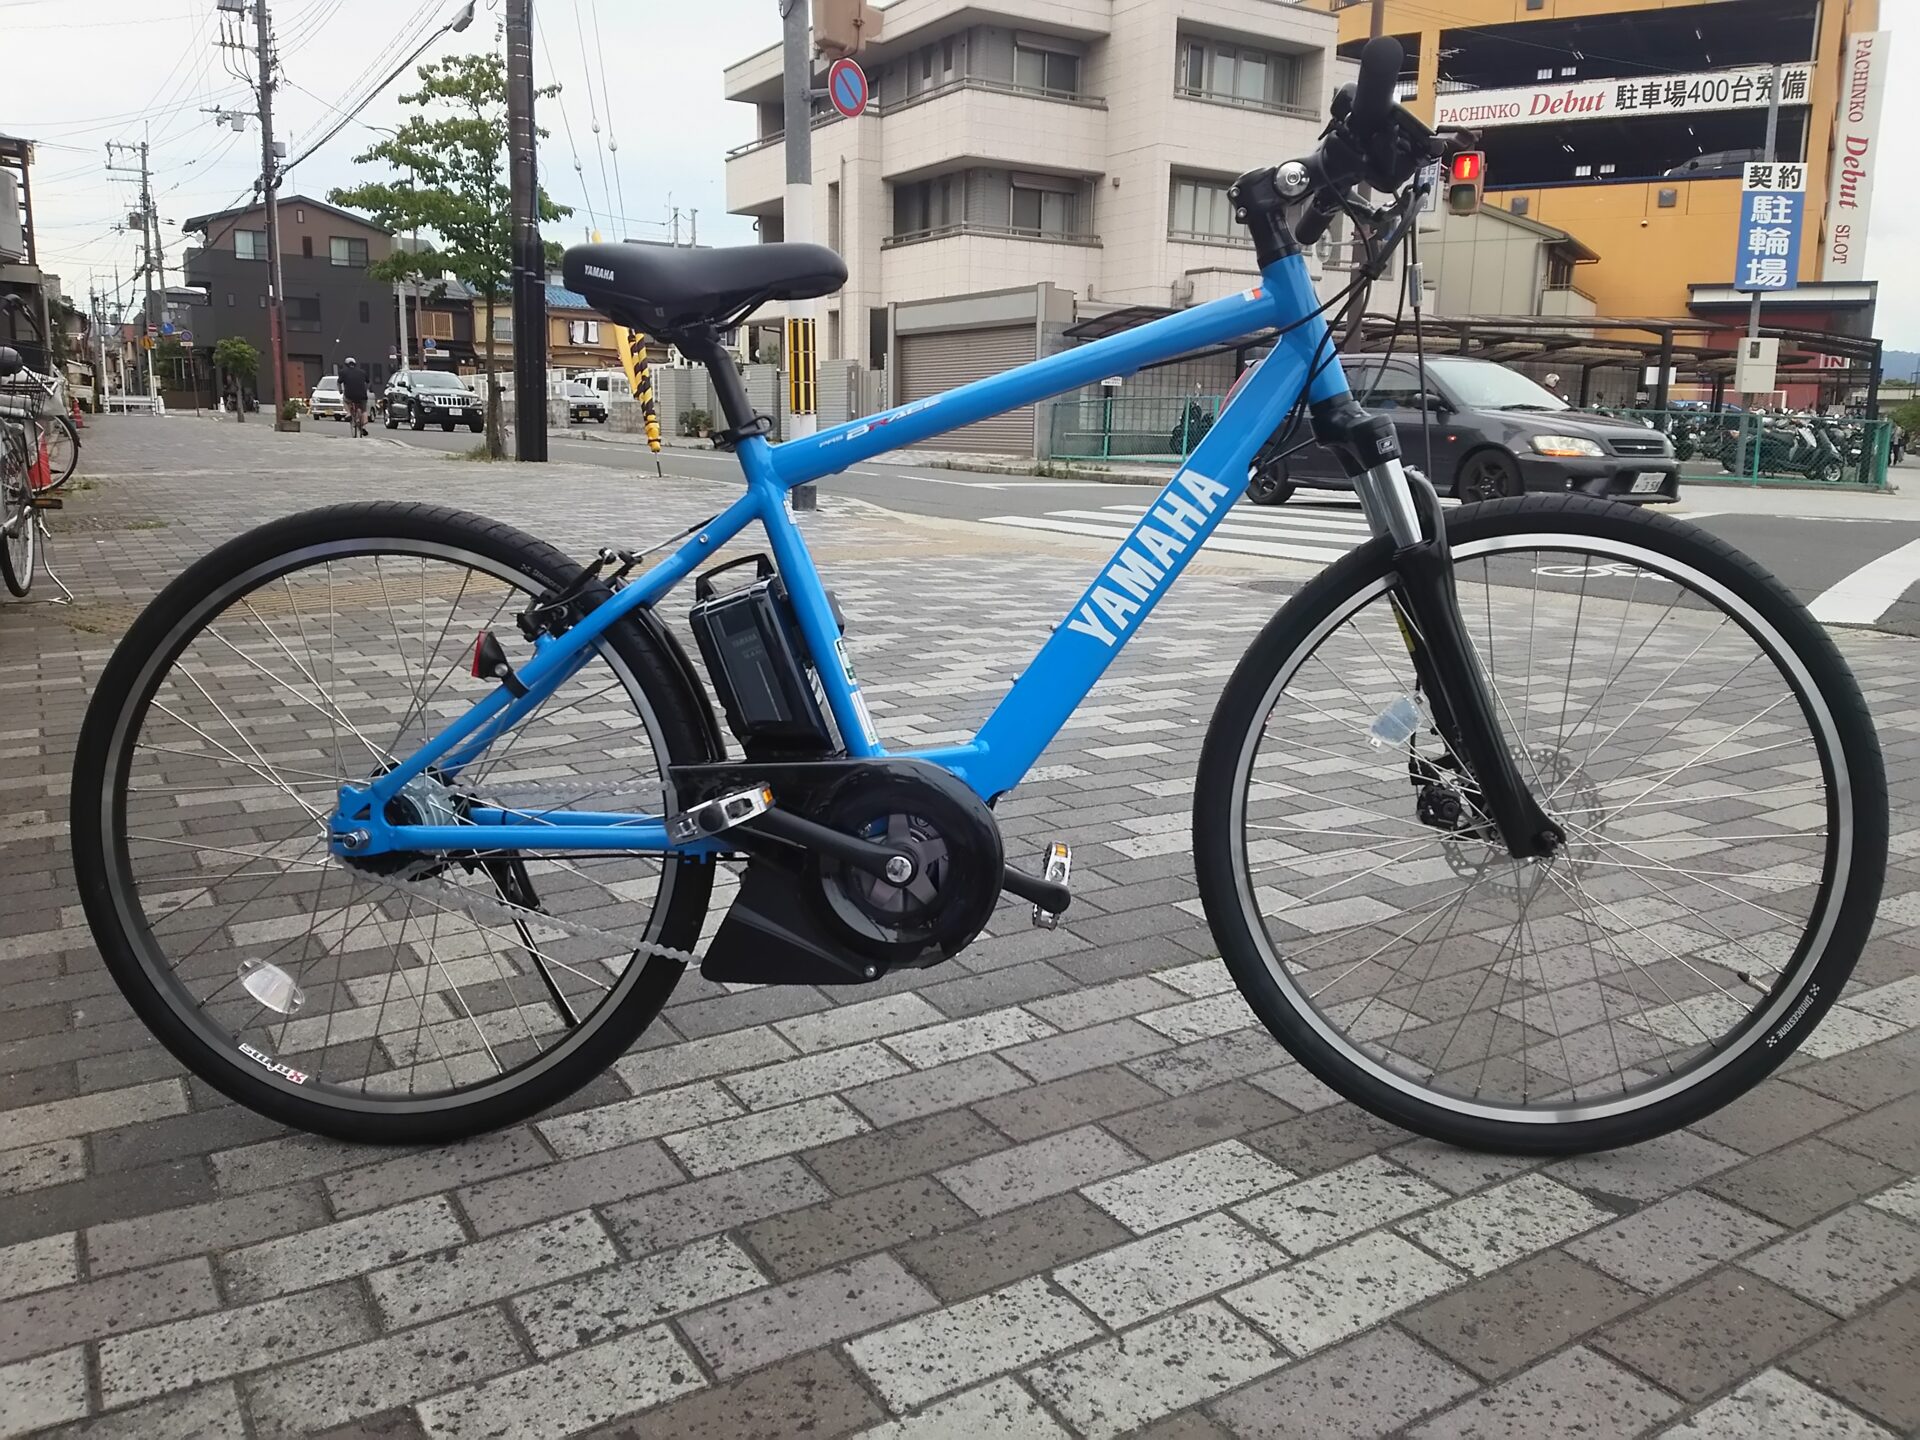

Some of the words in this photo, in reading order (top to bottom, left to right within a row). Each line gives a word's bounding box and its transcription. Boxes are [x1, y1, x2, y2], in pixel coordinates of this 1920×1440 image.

[1848, 38, 1873, 123] PACHINKO
[1439, 102, 1521, 123] PACHINKO
[1528, 89, 1607, 116] Debut
[1748, 165, 1802, 190] 契約
[1839, 135, 1869, 209] Debut
[1745, 195, 1794, 287] 駐輪場
[1832, 224, 1851, 264] SLOT
[584, 264, 615, 282] YAMAHA
[1824, 356, 1845, 368] IN
[1067, 469, 1230, 647] YAMAHA
[1776, 995, 1814, 1039] BRIDGESTONE
